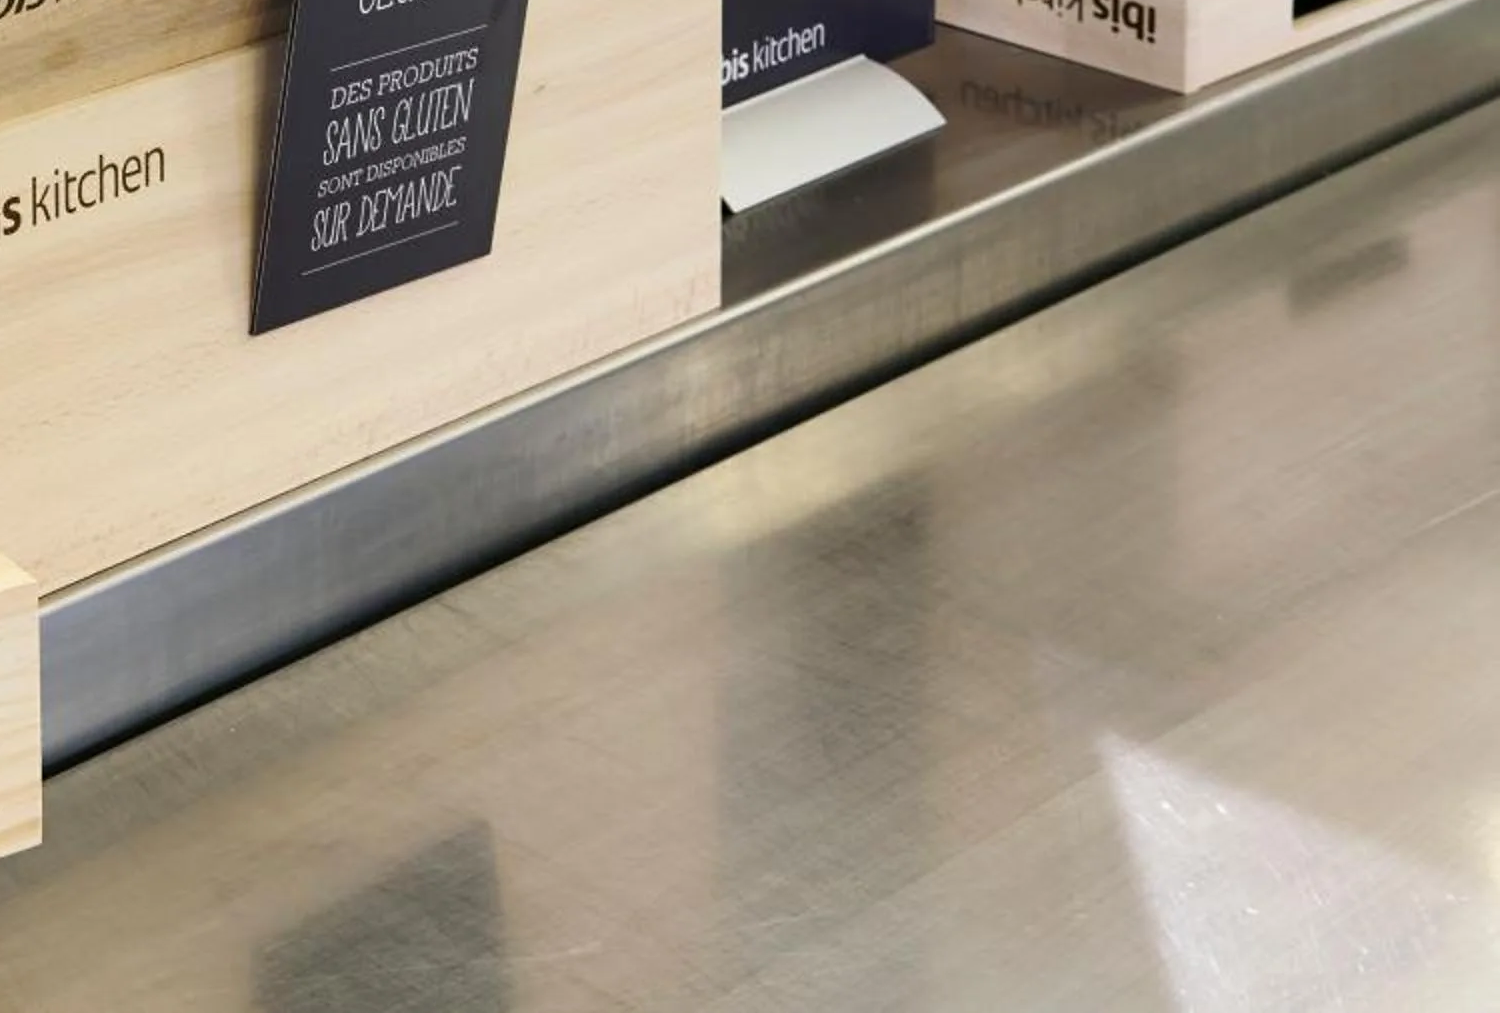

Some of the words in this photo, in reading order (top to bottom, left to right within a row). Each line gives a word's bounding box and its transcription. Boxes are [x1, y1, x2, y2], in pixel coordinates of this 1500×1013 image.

[329, 78, 373, 110] DES
[377, 46, 479, 96] PRODUITS
[721, 47, 750, 86] bis
[753, 22, 825, 73] kitchen
[323, 106, 385, 166] SANS
[391, 77, 475, 144] GLUTEN
[31, 145, 166, 227] kitchen
[317, 168, 365, 198] SONT
[365, 136, 467, 183] DISPONIBLES
[311, 201, 351, 252] SUR
[356, 165, 463, 237] DEMANDE
